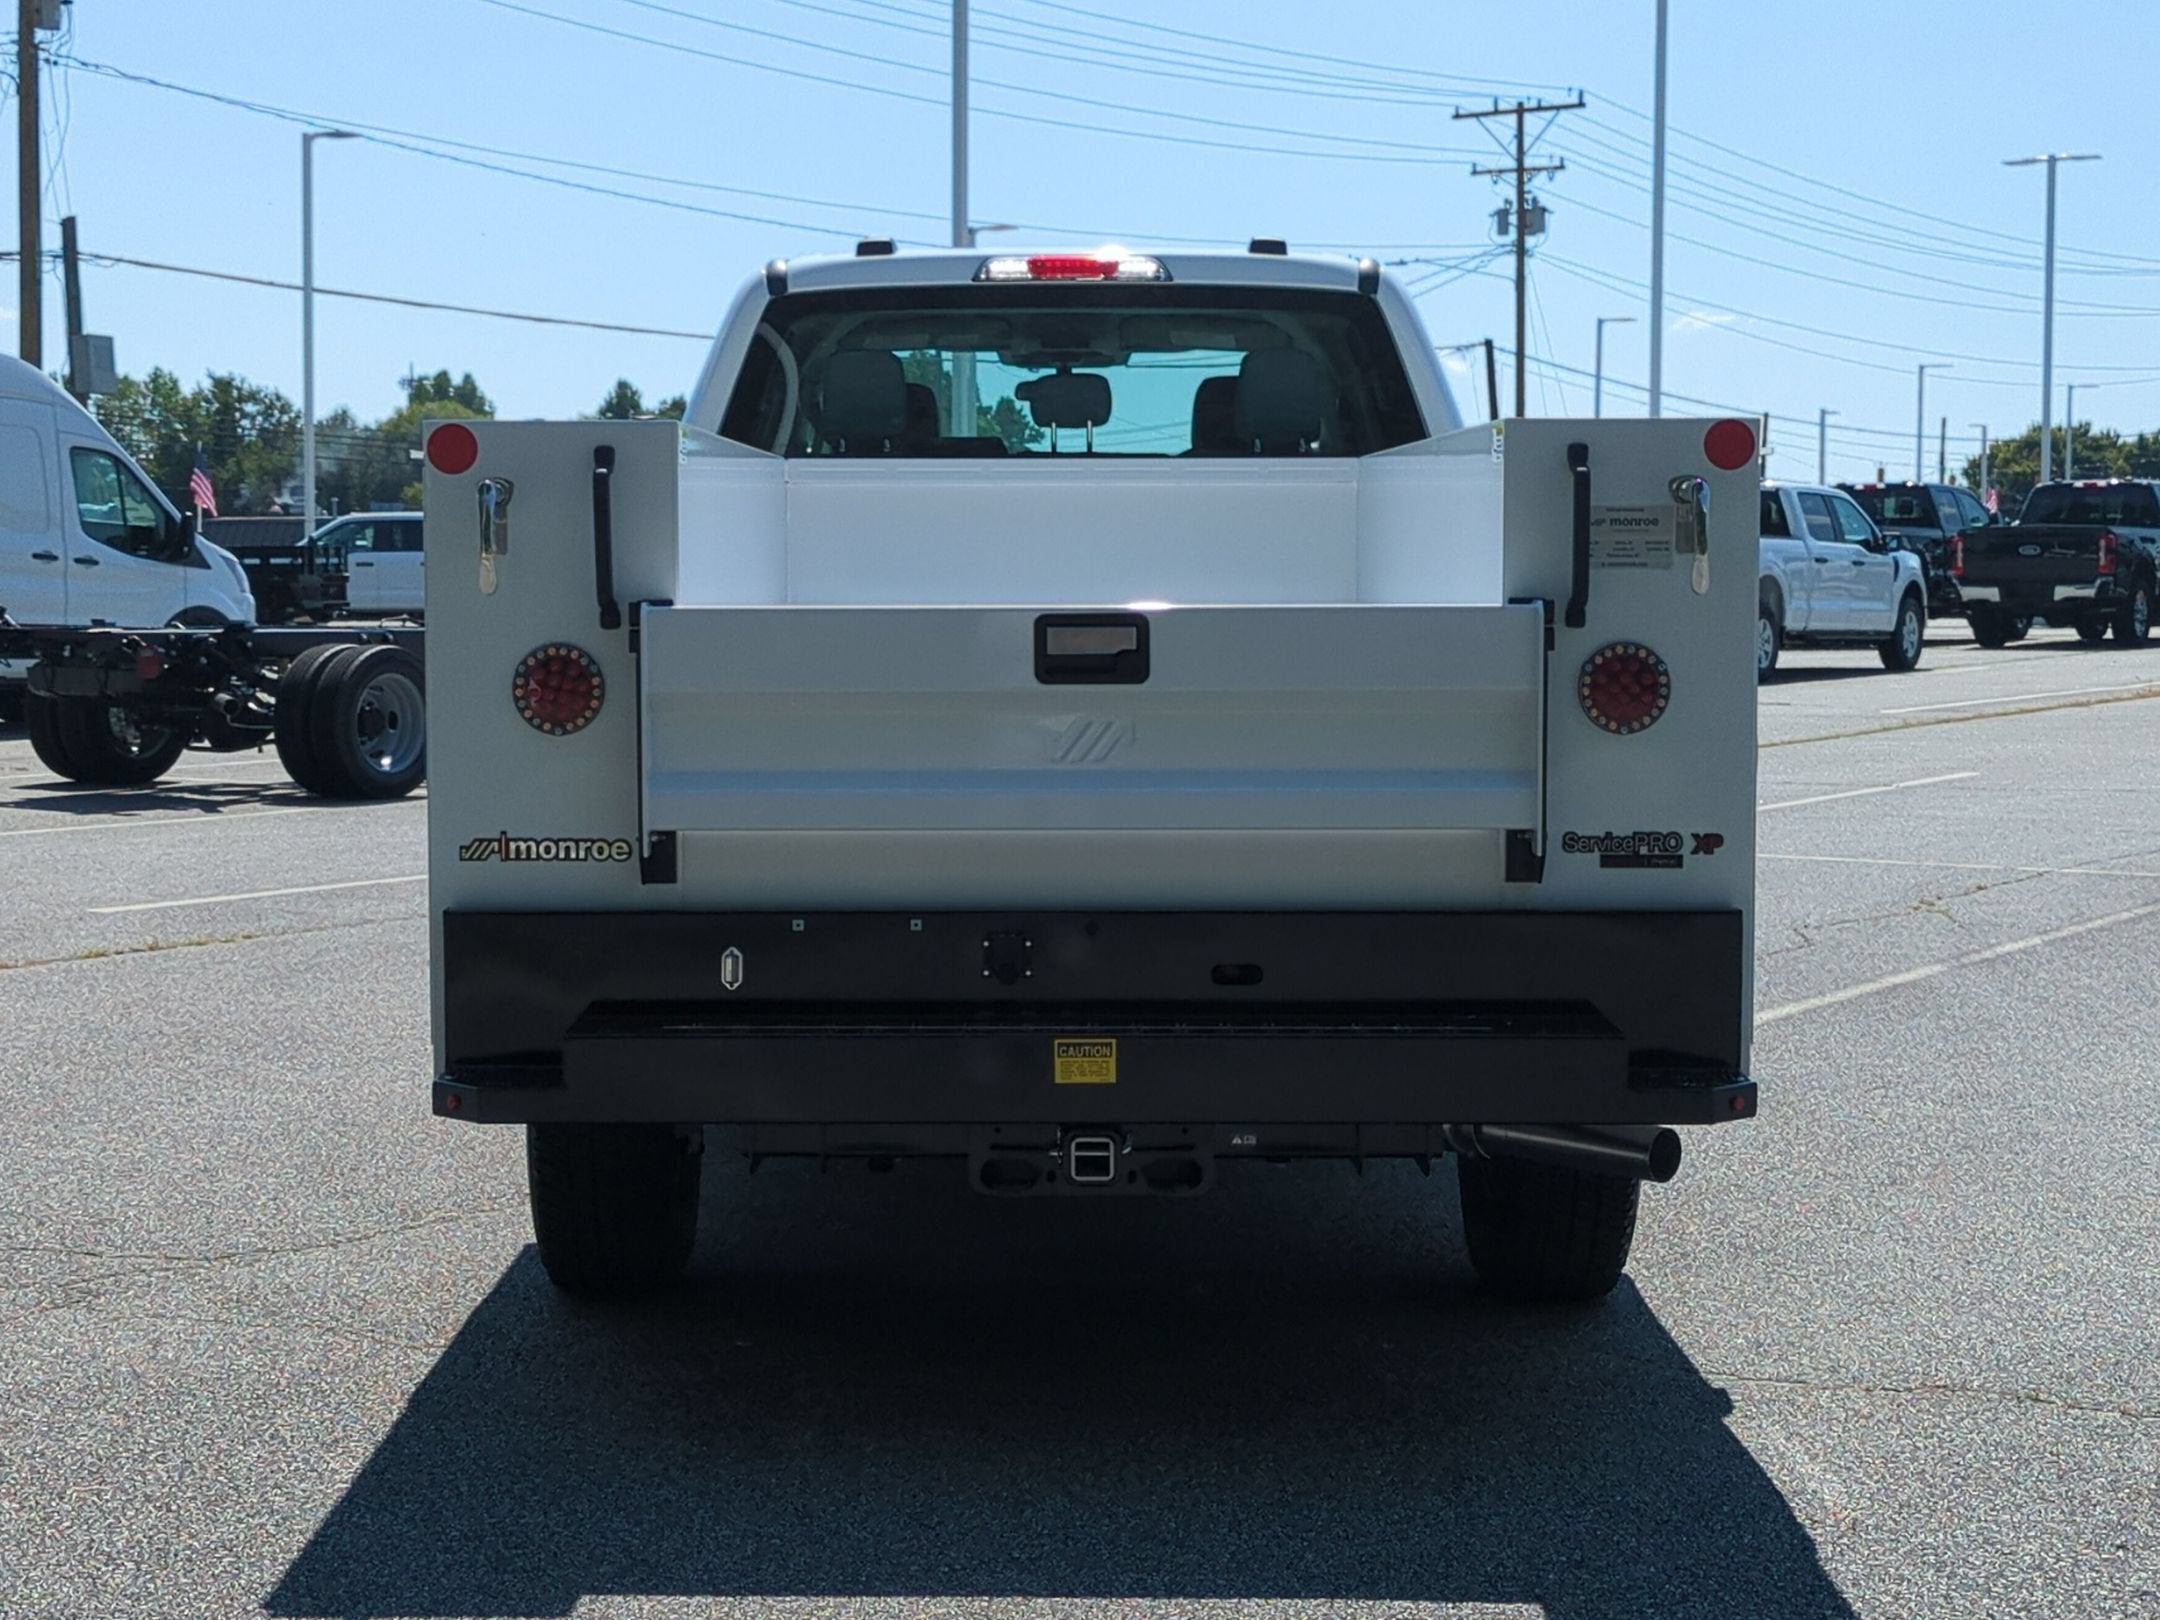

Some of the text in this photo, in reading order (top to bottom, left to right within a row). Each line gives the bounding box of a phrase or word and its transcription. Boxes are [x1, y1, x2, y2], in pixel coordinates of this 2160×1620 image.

[1609, 517, 1659, 527] monroe
[508, 837, 632, 861] monroe
[1563, 831, 1684, 854] ServicePRO
[1059, 1045, 1112, 1058] CAUTION
